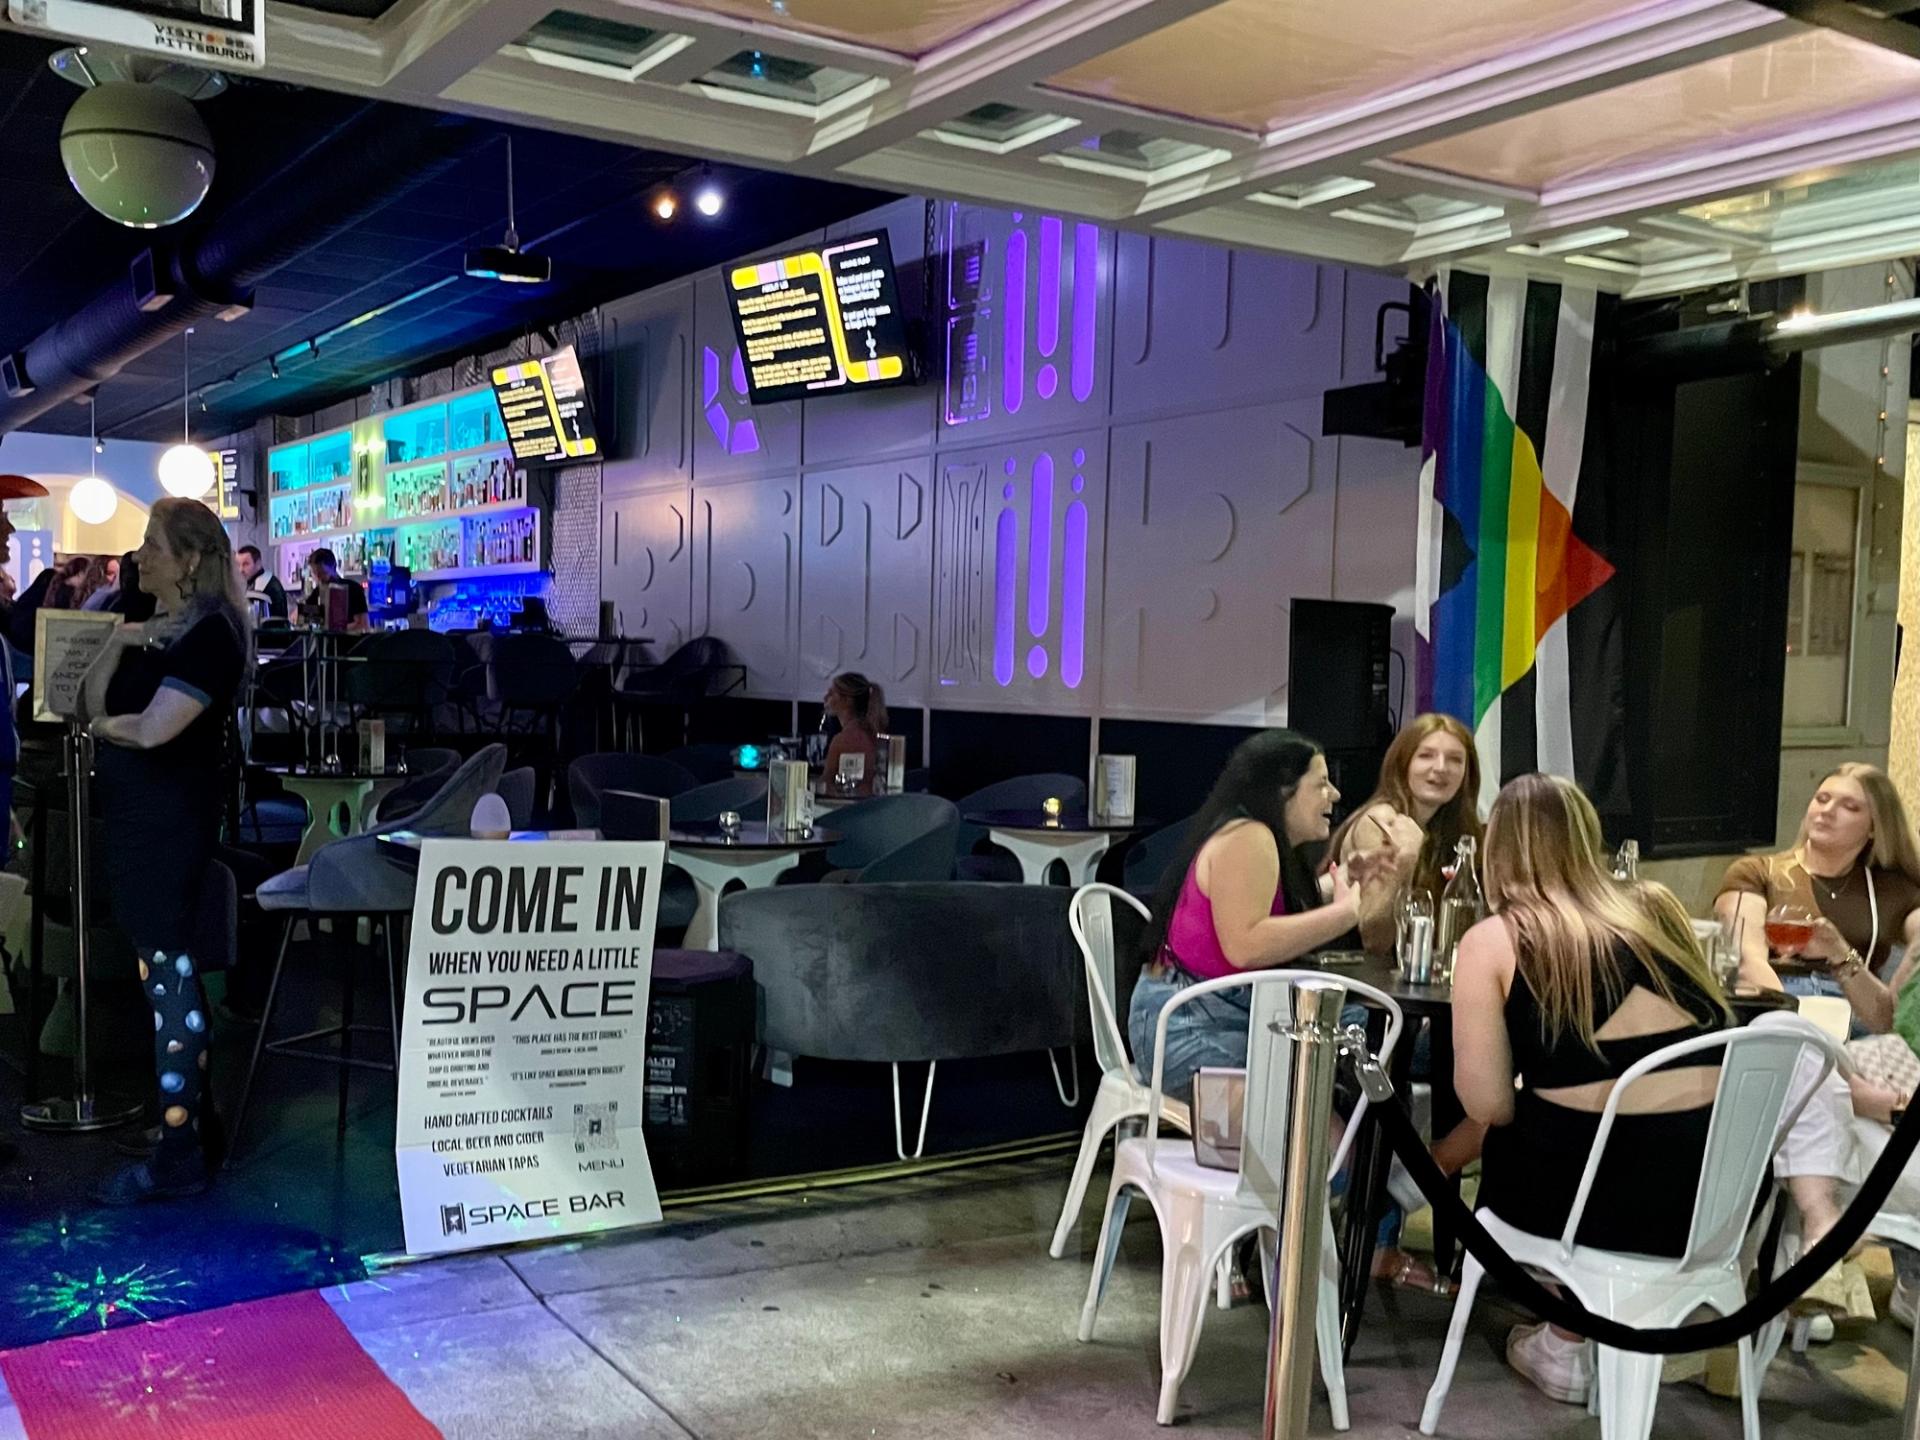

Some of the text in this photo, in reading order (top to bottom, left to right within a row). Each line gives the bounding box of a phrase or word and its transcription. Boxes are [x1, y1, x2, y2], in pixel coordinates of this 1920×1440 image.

[154, 23, 203, 41] VISIT
[154, 35, 255, 62] PITTSBURGH
[431, 865, 647, 935] COME IN
[429, 947, 640, 975] WHEN YOU NEED A LITTLE
[422, 980, 636, 1025] SPACE
[531, 1033, 551, 1044] PLACE
[553, 1032, 567, 1042] HAS
[568, 1031, 580, 1041] THE
[581, 1030, 598, 1041] BEST
[477, 1063, 489, 1071] AND
[524, 1071, 536, 1080] LIKE
[538, 1069, 555, 1079] SPACE
[424, 1106, 553, 1130] HAND CRAFTED COCKTAILS
[431, 1131, 544, 1153] LOCAL BEER AND CIDER
[443, 1154, 539, 1177] VEGETARIAN TAPAS
[578, 1158, 625, 1173] MENU
[469, 1190, 626, 1226] SPACE BAR
